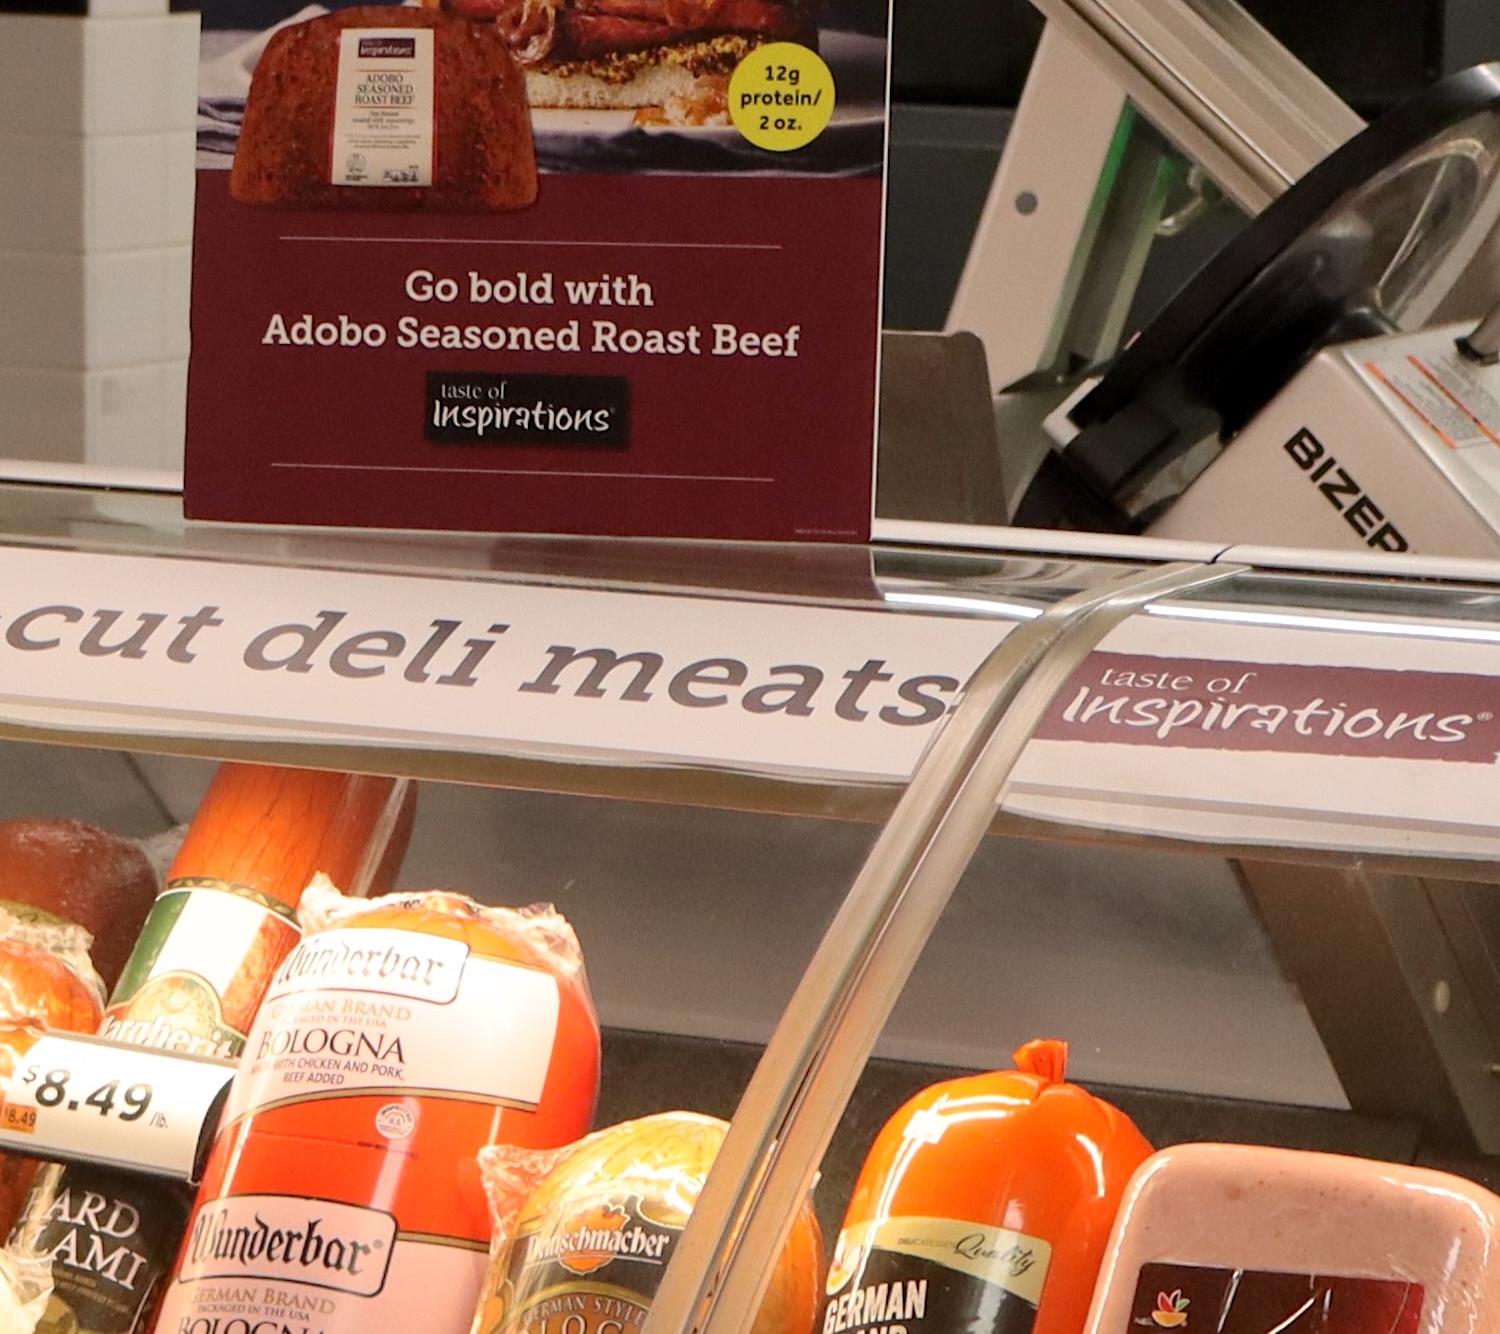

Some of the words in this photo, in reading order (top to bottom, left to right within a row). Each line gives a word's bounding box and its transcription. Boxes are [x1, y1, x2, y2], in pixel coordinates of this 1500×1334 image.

[763, 64, 801, 87] 12g
[739, 87, 823, 110] protein/
[758, 114, 771, 131] 2
[776, 117, 803, 132] oz.
[404, 270, 460, 305] Go
[468, 271, 554, 307] bold
[563, 274, 655, 308] with
[261, 315, 388, 349] Adobo
[397, 317, 581, 355] Seasoned
[590, 321, 701, 357] Roast
[711, 323, 801, 359] Beef
[440, 381, 480, 400] taste
[487, 381, 506, 401] of
[431, 398, 611, 436] Inspirations
[241, 609, 481, 690] deli
[1101, 667, 1195, 694] taste
[1204, 671, 1257, 695] of
[342, 998, 412, 1022] BRAND
[256, 1027, 406, 1065] BOLOGNA
[283, 1071, 305, 1084] BEEF
[307, 1072, 345, 1085] ADDED
[296, 1057, 341, 1071] CHICKEN
[342, 1060, 369, 1073] AND
[22, 1064, 154, 1123] $8.49
[955, 1232, 1036, 1277] Quality
[262, 1288, 336, 1315] BRAND
